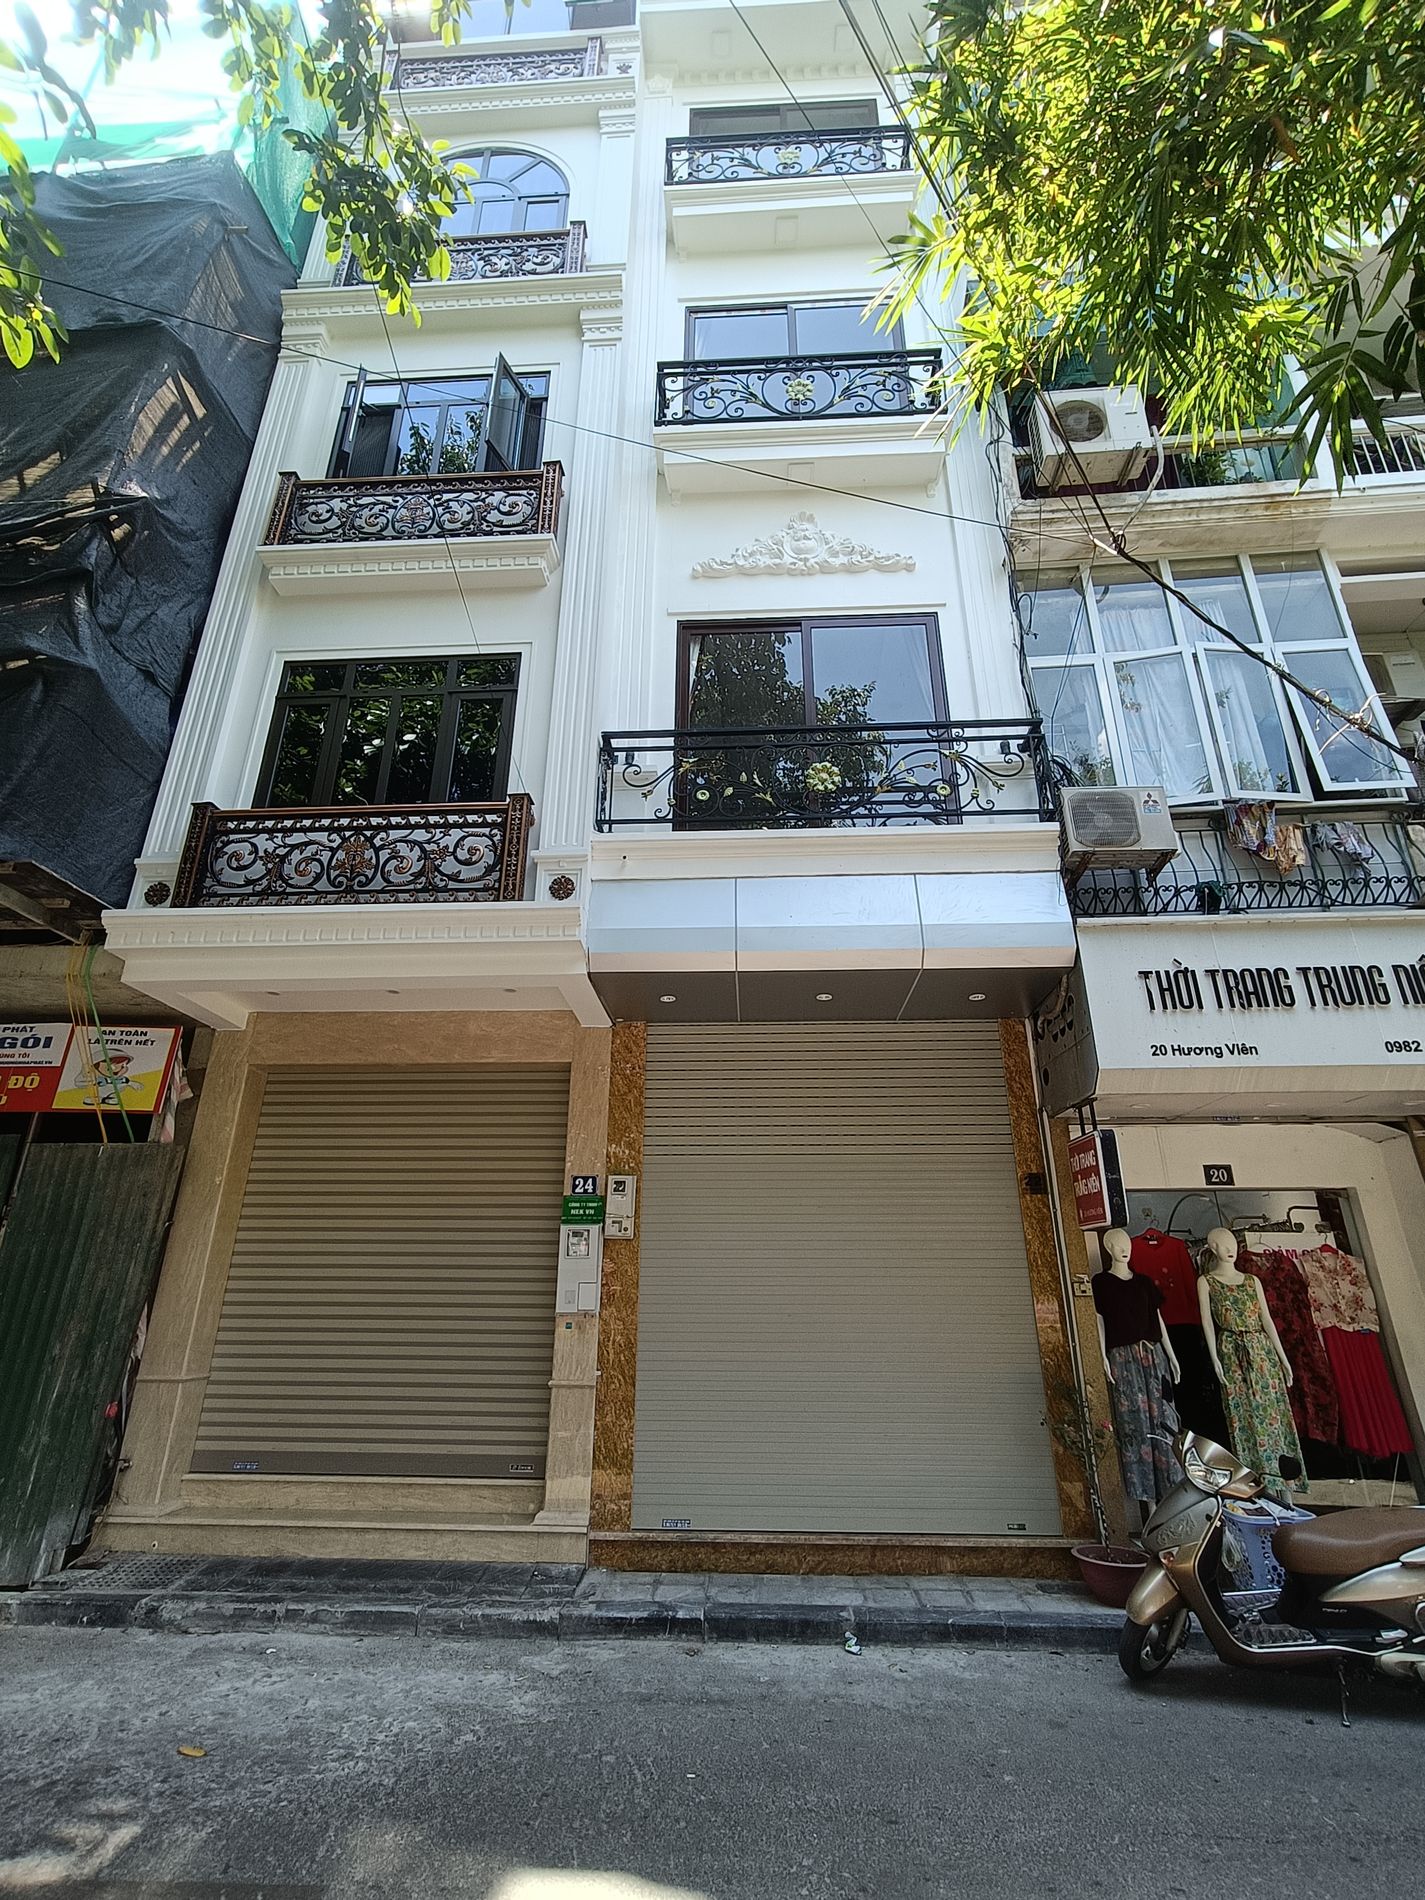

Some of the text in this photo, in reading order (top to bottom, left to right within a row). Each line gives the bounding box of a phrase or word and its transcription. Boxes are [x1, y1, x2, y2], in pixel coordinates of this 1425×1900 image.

[1138, 958, 1204, 1012] THỜI
[1204, 967, 1296, 1011] TRANG
[1296, 964, 1391, 1009] TRUNG
[119, 1029, 148, 1037] TOÀN
[103, 1038, 132, 1046] TRÊN
[1384, 1040, 1423, 1053] 0982
[1150, 1043, 1259, 1059] 20 Hương Viên
[8, 1073, 40, 1091] ĐỘ
[1210, 1169, 1228, 1183] 20
[574, 1178, 594, 1193] 24
